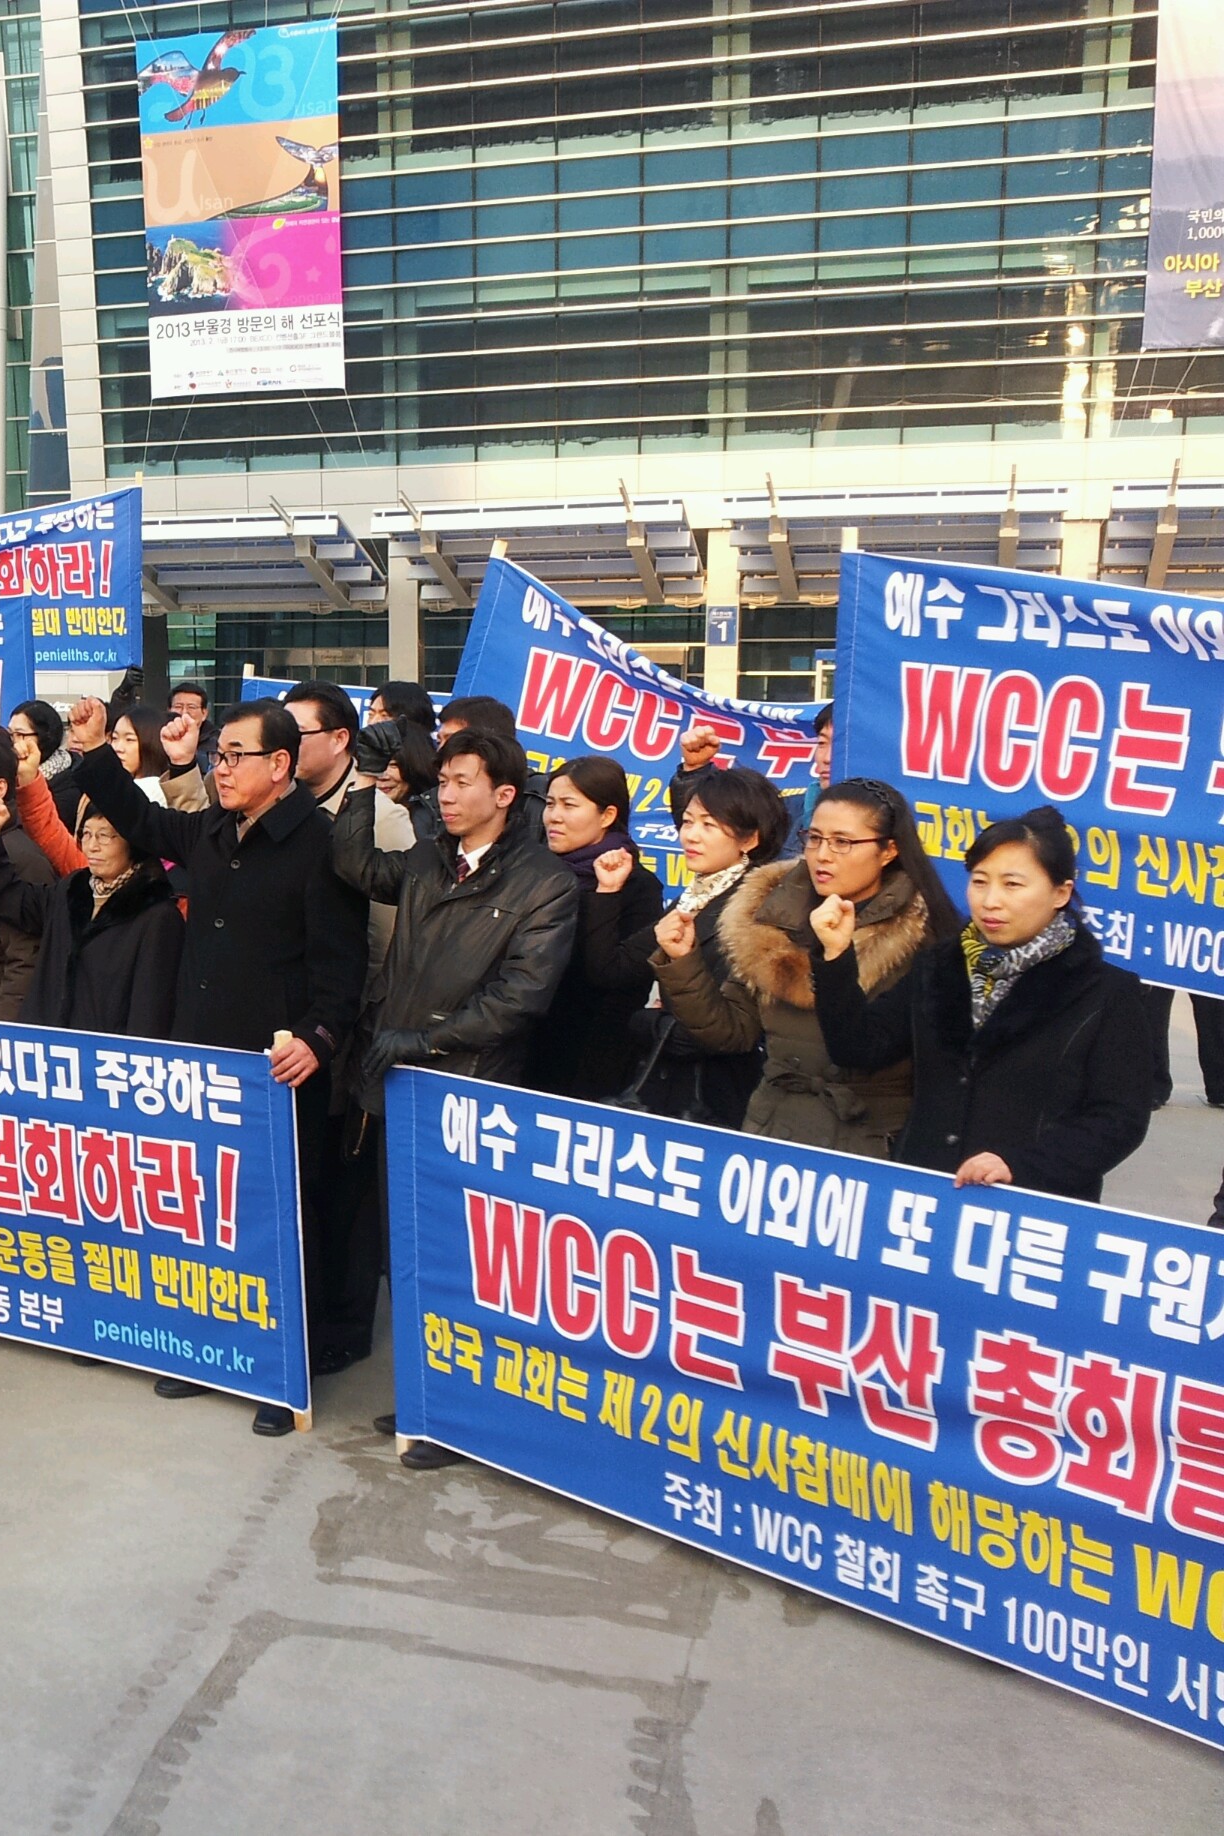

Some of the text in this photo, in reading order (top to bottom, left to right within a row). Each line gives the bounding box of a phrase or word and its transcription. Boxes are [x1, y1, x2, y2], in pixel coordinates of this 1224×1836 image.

[1187, 226, 1224, 242] 1,000
[1164, 252, 1220, 273] 아시아
[1184, 278, 1222, 299] 부산
[156, 310, 341, 340] 2013 부울경 방문의 해 선포식
[34, 501, 115, 535] 주장하는
[65, 607, 128, 637] 반대한다.
[717, 620, 728, 642] 1
[884, 570, 966, 640] 예수
[975, 583, 1151, 653] 그리스도
[34, 648, 118, 664] penielths.or.kr
[900, 660, 1192, 818] WCC는
[94, 1048, 242, 1127] 주장하는
[440, 1091, 519, 1172] 예수
[531, 1112, 707, 1219] 그리스도
[718, 1151, 870, 1262] 이외에
[880, 1187, 940, 1276] 또
[951, 1202, 1070, 1310] 다른
[18, 1288, 65, 1334] 본부
[80, 1239, 143, 1301] 절대
[150, 1252, 278, 1331] 반대한다.
[93, 1316, 255, 1376] penielths.or.kr
[462, 1186, 746, 1392] WCC는
[767, 1271, 946, 1453] 부산
[423, 1311, 484, 1386] 한국
[492, 1335, 590, 1425] 교회는
[712, 1409, 914, 1537] 신사참배에
[926, 1478, 1115, 1606] 해당하는
[663, 1470, 723, 1536] 주최
[751, 1502, 823, 1572] WCC
[833, 1531, 902, 1604] 철회
[914, 1561, 987, 1632] 촉구
[1001, 1596, 1151, 1698] 100만인
